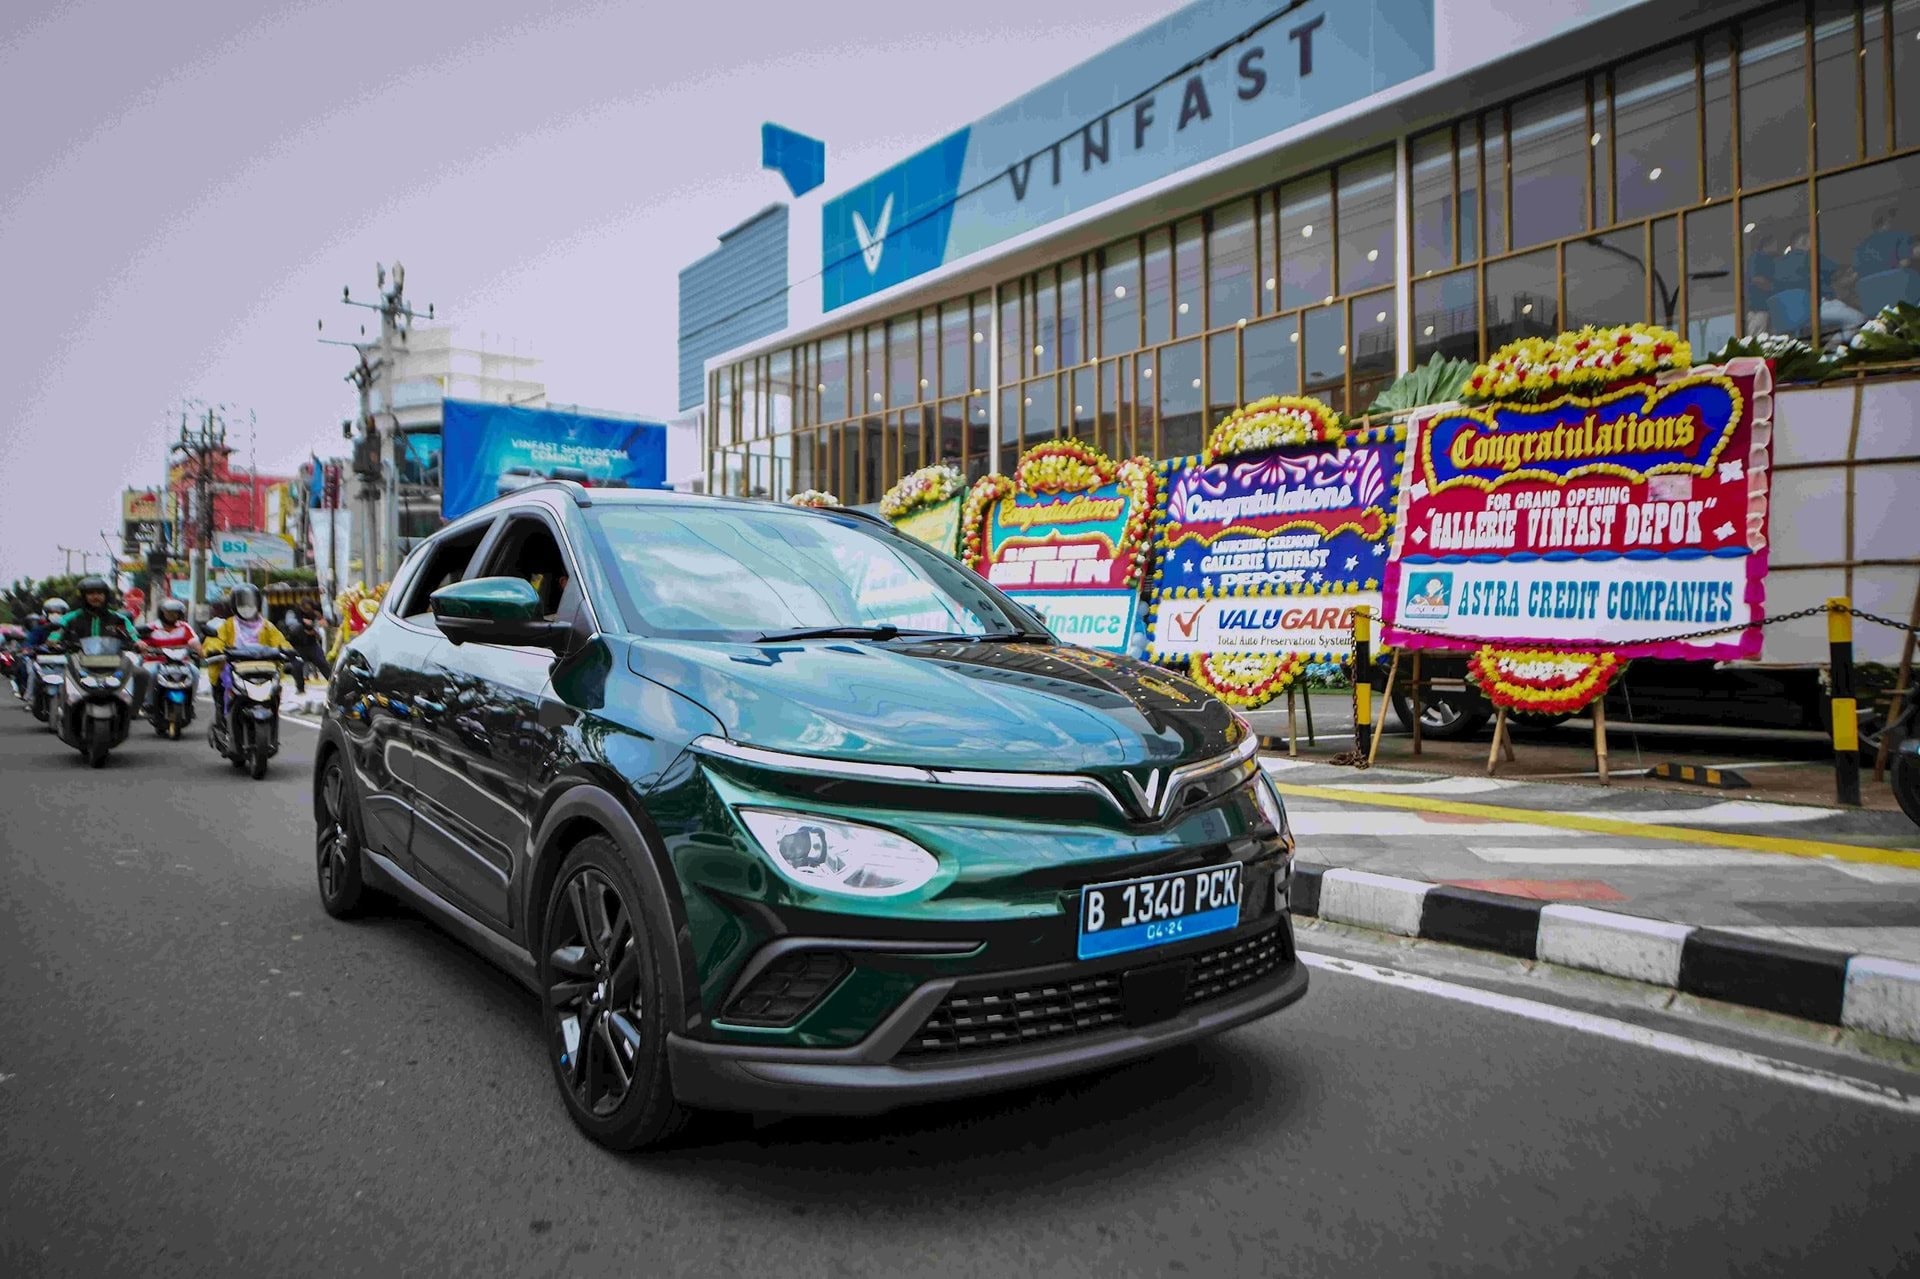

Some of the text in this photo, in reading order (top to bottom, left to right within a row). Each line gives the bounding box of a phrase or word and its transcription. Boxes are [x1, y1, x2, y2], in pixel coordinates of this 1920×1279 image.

[1008, 13, 1326, 200] VINFAST
[1451, 412, 1696, 470] Congratulations
[1187, 484, 1354, 526] Congratulations
[1486, 485, 1630, 511] FOR GRAND OPENING
[222, 540, 248, 553] BSI
[1526, 504, 1616, 548] VINFAST
[1221, 570, 1306, 585] DEPOK
[1457, 580, 1733, 624] ASTRA CREDIT COMPANIES
[1218, 635, 1238, 646] Total
[1240, 635, 1258, 646] Auto
[1260, 634, 1316, 647] Preservation
[1087, 866, 1238, 933] B 1340 PCK
